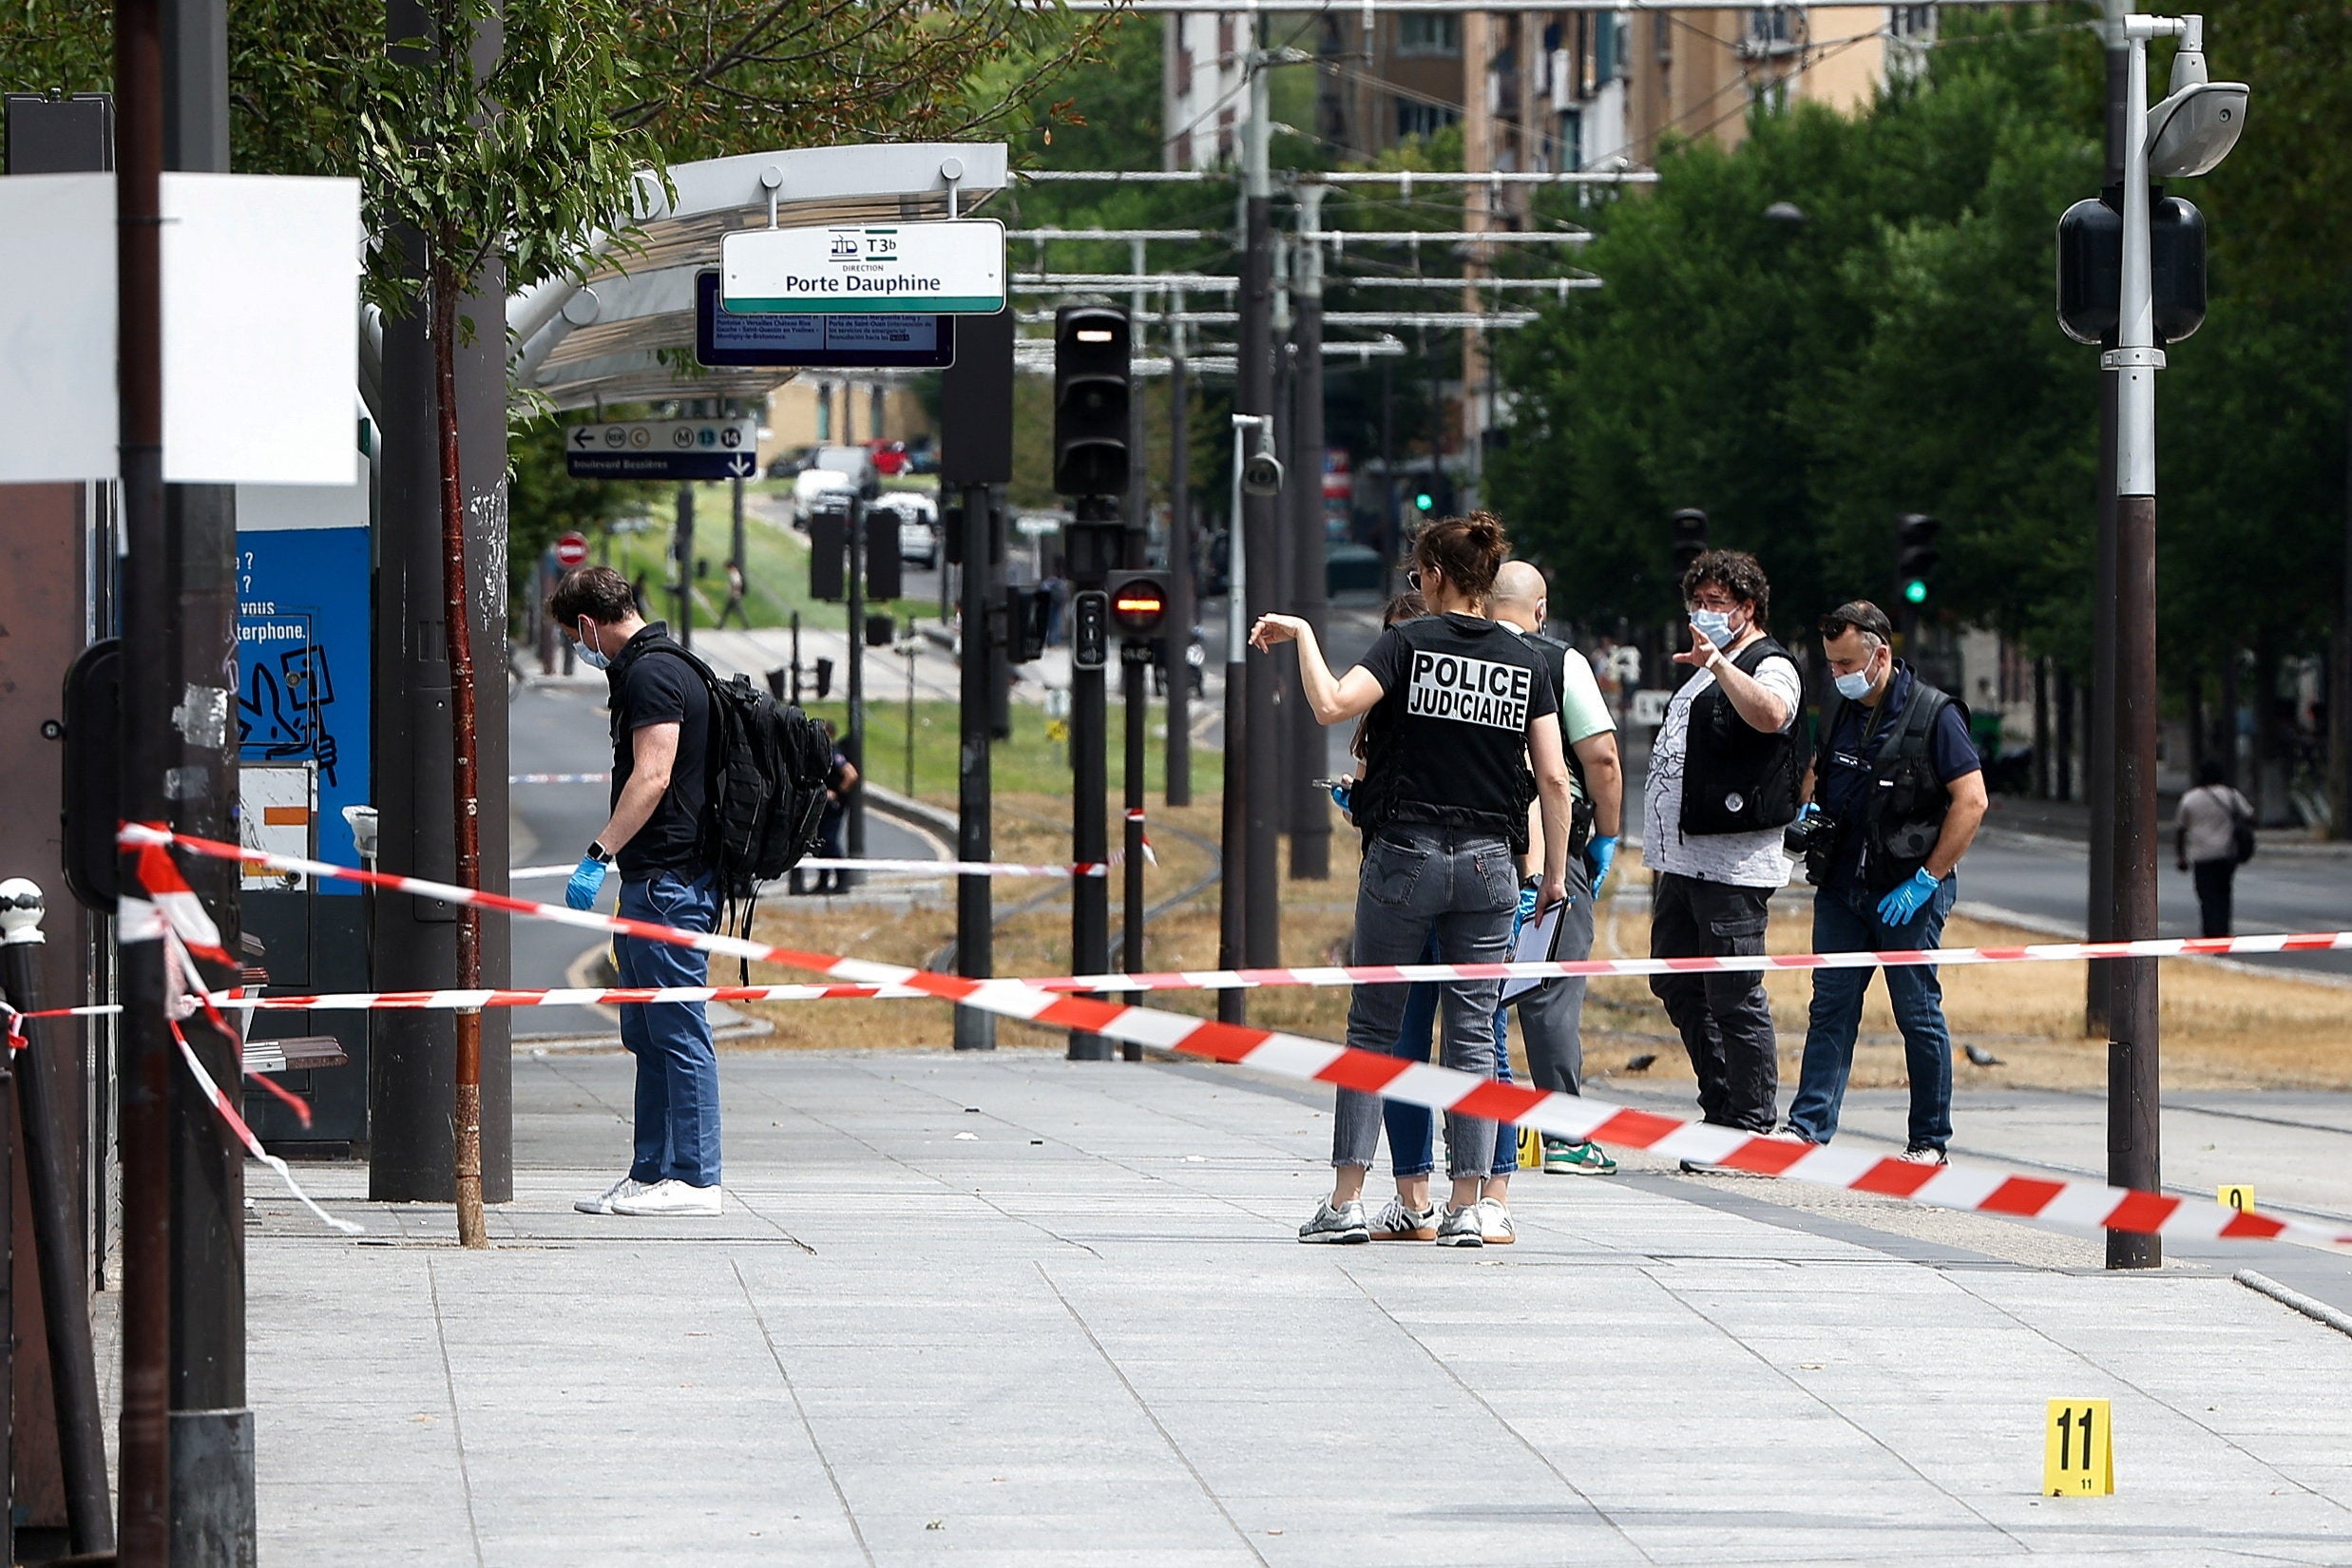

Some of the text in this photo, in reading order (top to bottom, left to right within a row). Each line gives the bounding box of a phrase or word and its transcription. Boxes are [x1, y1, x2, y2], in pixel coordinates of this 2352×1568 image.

[867, 239, 896, 252] T3b
[787, 275, 941, 295] Porte Dauphine
[699, 431, 714, 444] 13
[724, 431, 738, 444] 14
[574, 459, 621, 469] boulevard
[240, 602, 276, 615] vous
[1412, 653, 1529, 700] POLICE
[1410, 687, 1525, 730] JUDICIAIRE
[2056, 1407, 2093, 1471] 11
[2081, 1478, 2092, 1490] 11
